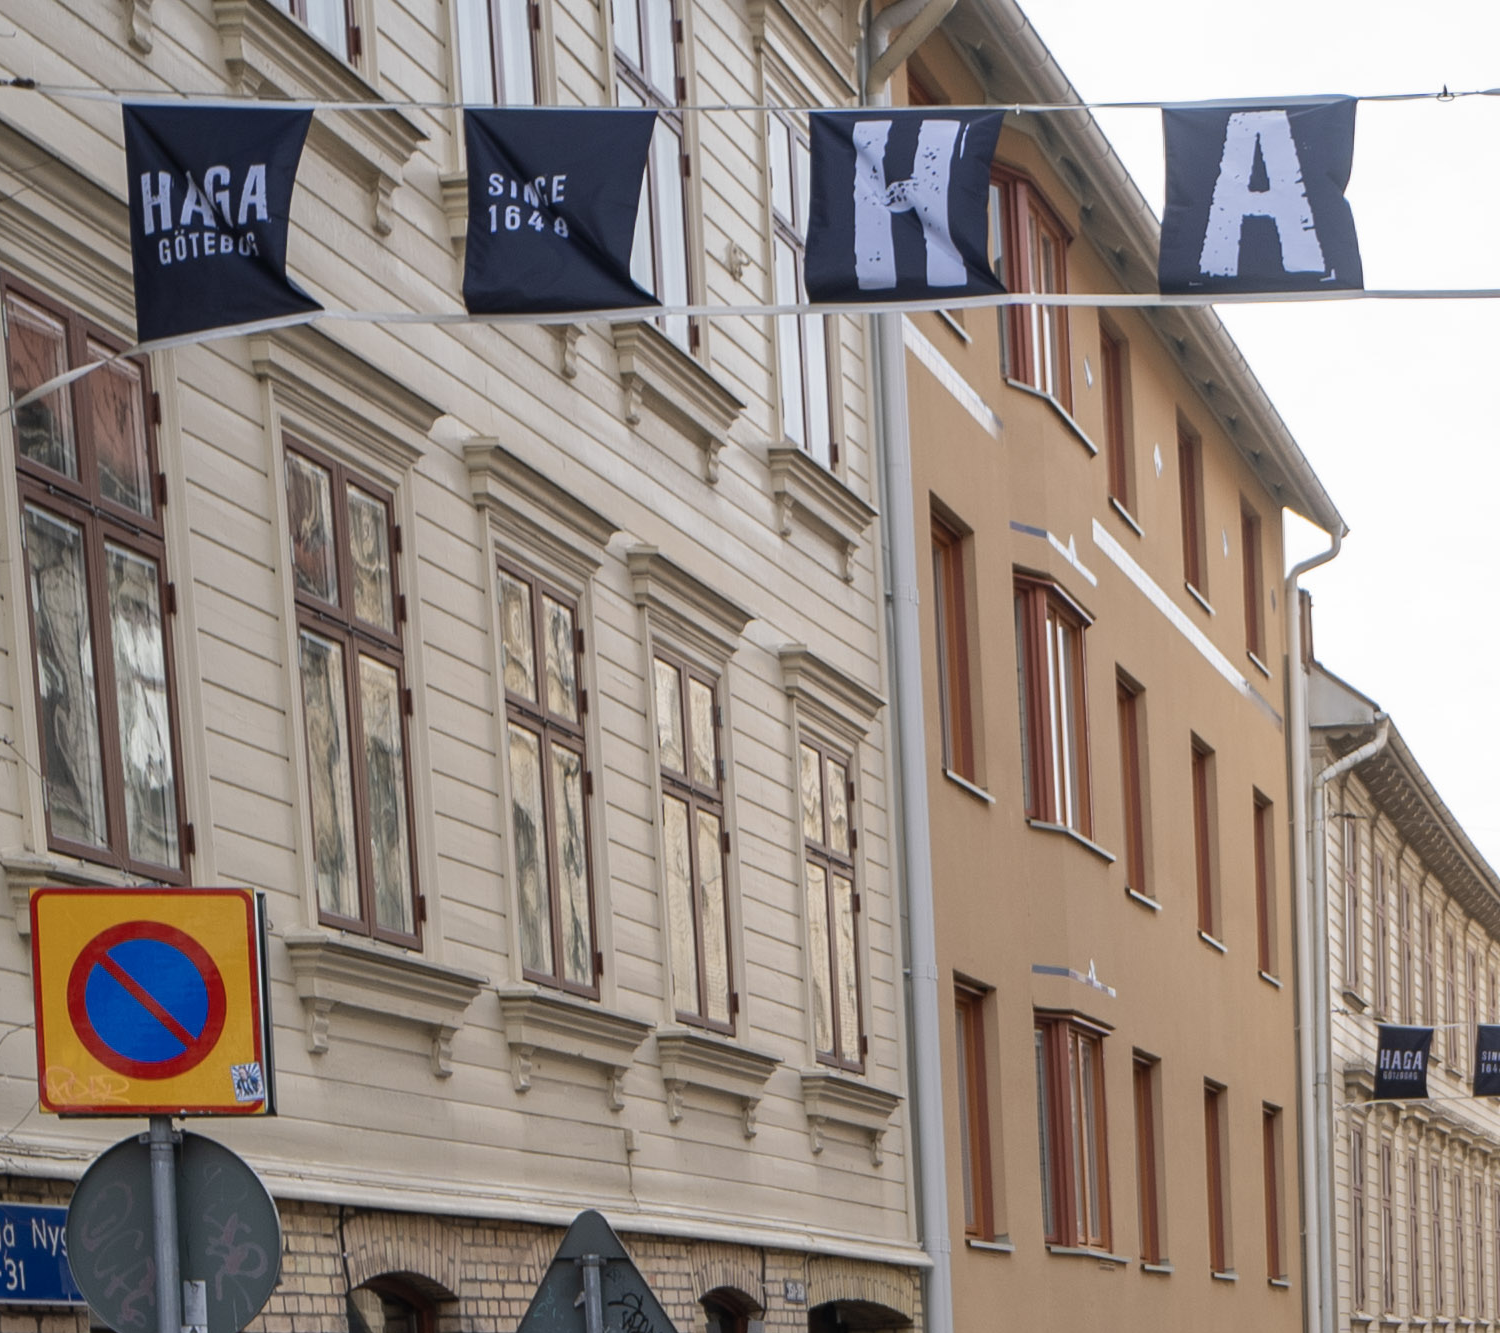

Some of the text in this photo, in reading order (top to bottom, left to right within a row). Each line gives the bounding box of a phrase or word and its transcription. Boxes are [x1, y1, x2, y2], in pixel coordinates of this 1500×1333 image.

[140, 164, 271, 236] HAGA
[488, 173, 567, 207] SINCE
[488, 205, 569, 238] 1648
[1379, 1049, 1423, 1071] HAGA
